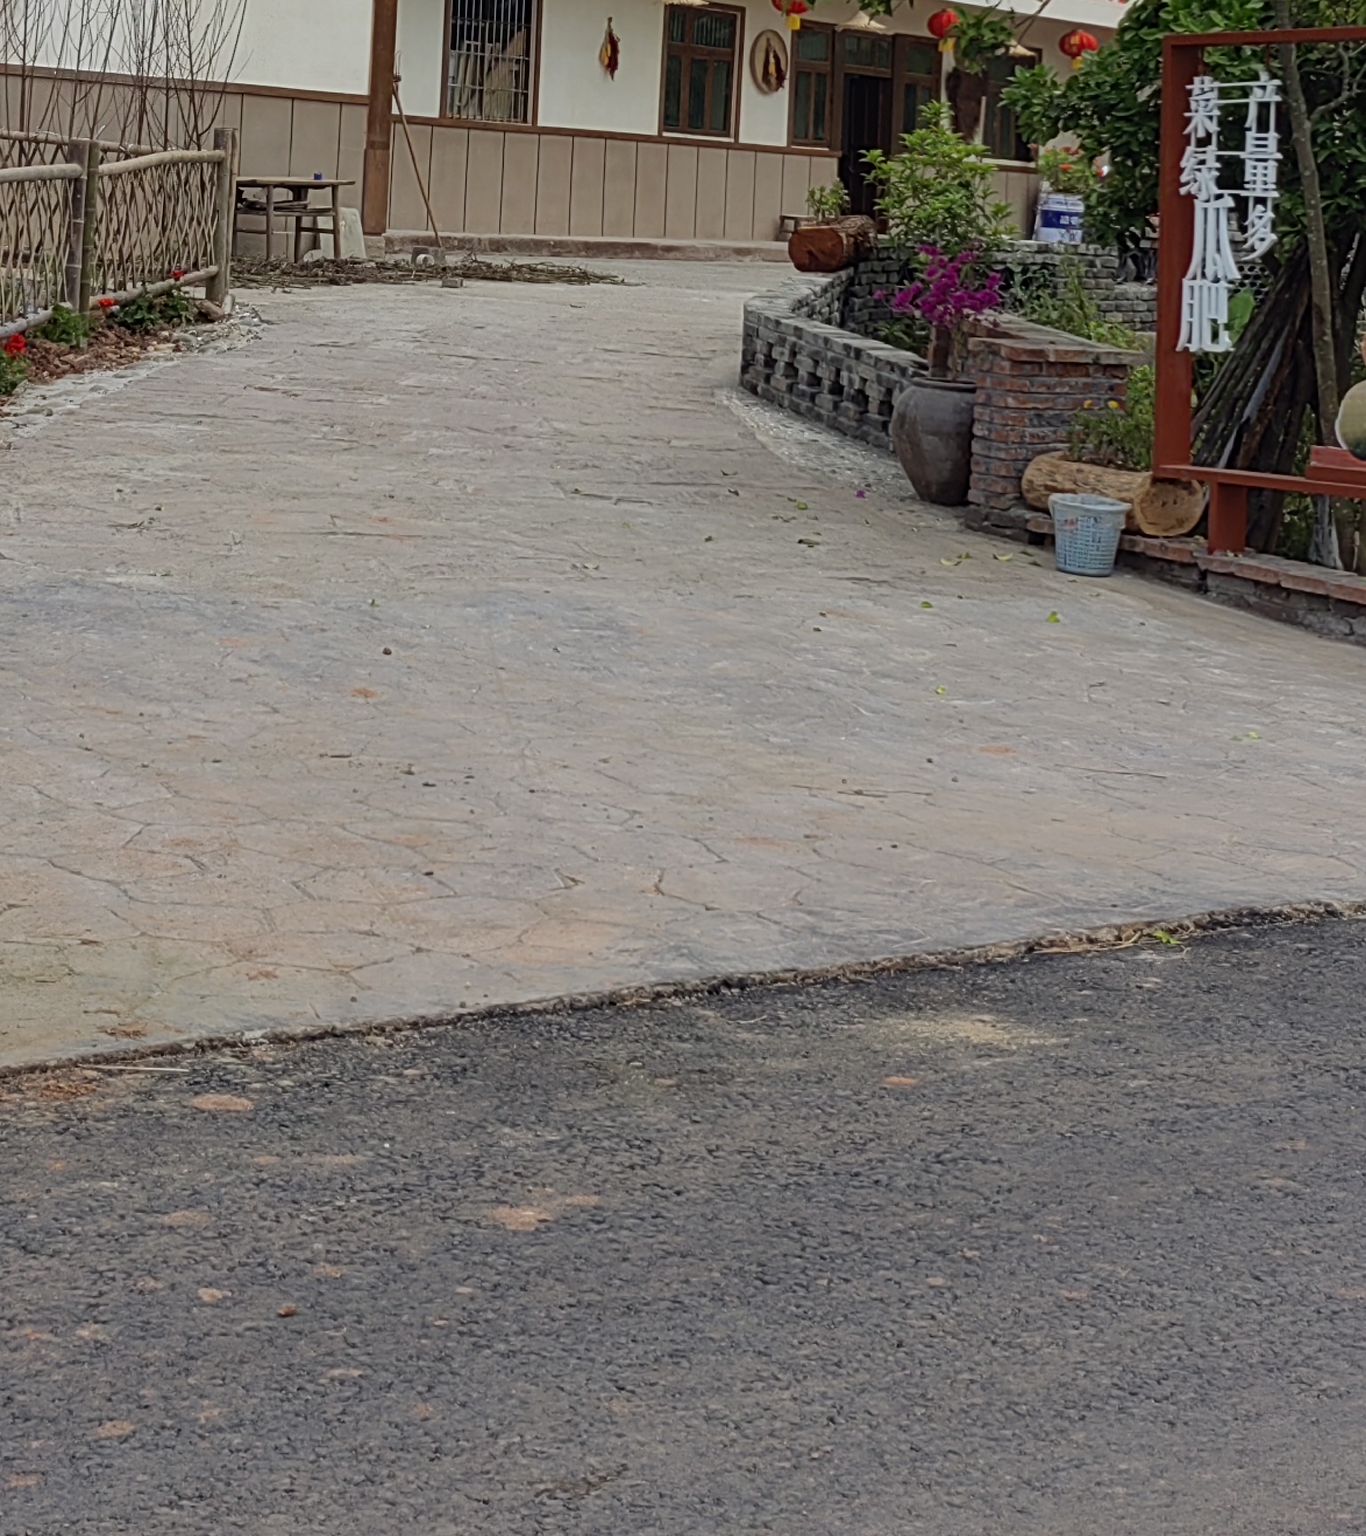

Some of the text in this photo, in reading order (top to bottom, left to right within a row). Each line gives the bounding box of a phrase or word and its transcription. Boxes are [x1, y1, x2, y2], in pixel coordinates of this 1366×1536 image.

[1176, 76, 1241, 352] 菜绿瓜肥
[1241, 72, 1283, 261] 产量多
